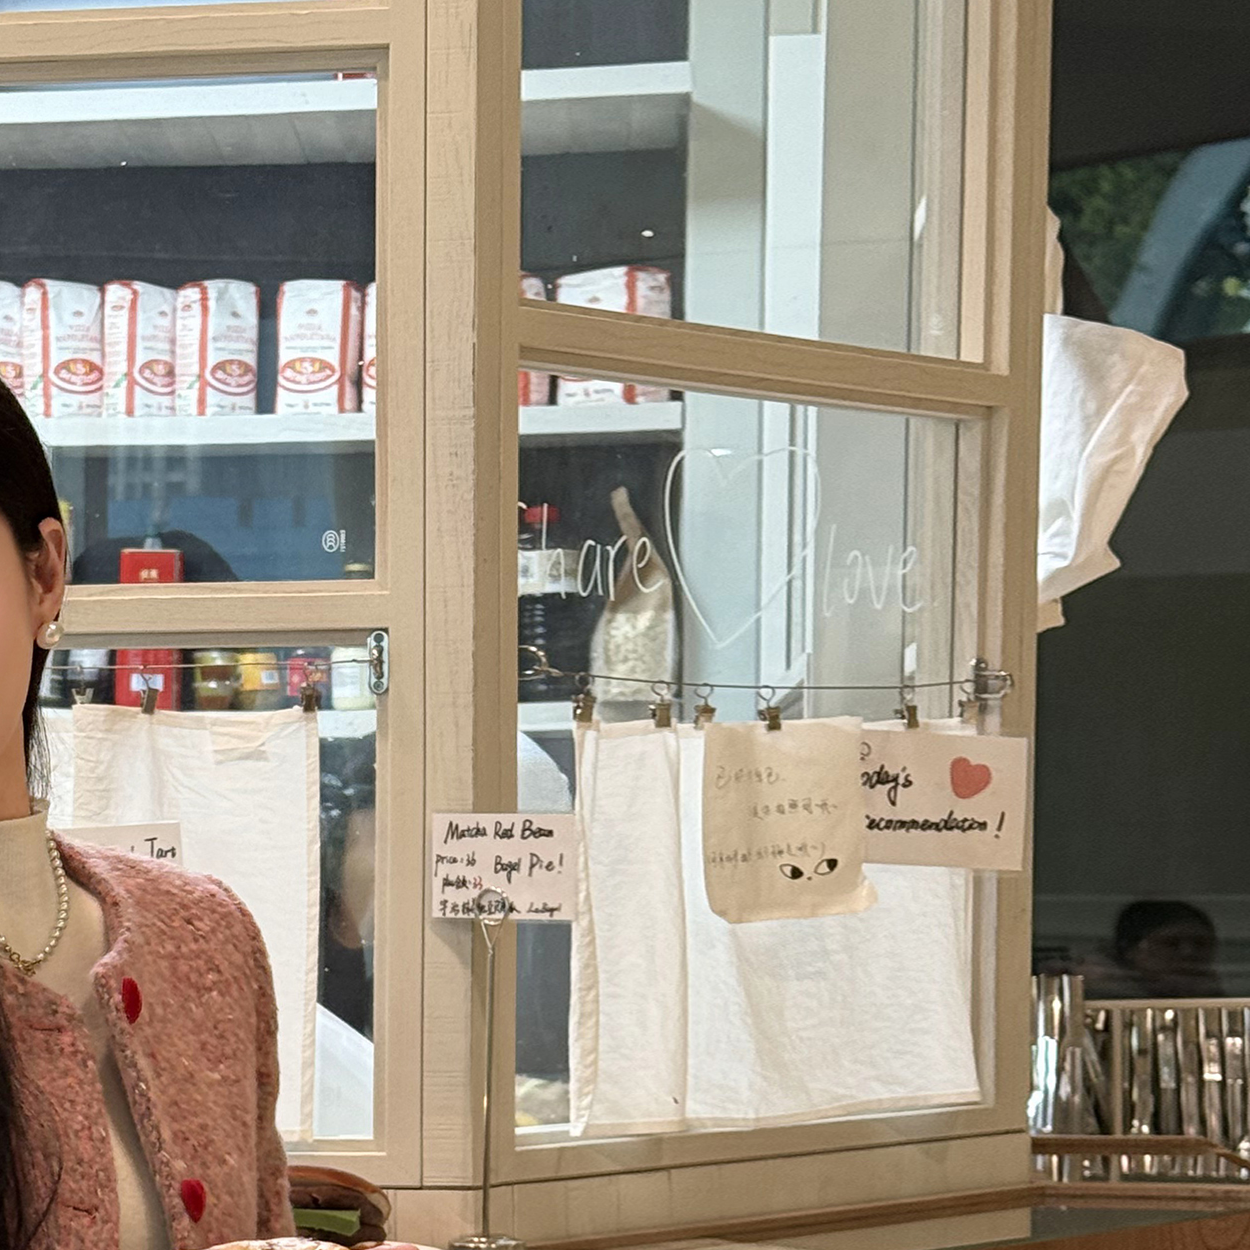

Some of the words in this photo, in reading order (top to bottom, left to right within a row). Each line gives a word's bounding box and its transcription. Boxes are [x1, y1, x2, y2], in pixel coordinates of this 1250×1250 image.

[518, 500, 664, 600] hare
[821, 524, 924, 617] love
[861, 764, 913, 807] oday's
[444, 820, 487, 844] Matcha
[493, 820, 515, 839] Red
[521, 819, 554, 840] Bean
[865, 810, 988, 834] ecommendation
[144, 837, 176, 859] Tart
[494, 855, 521, 884] Bagel
